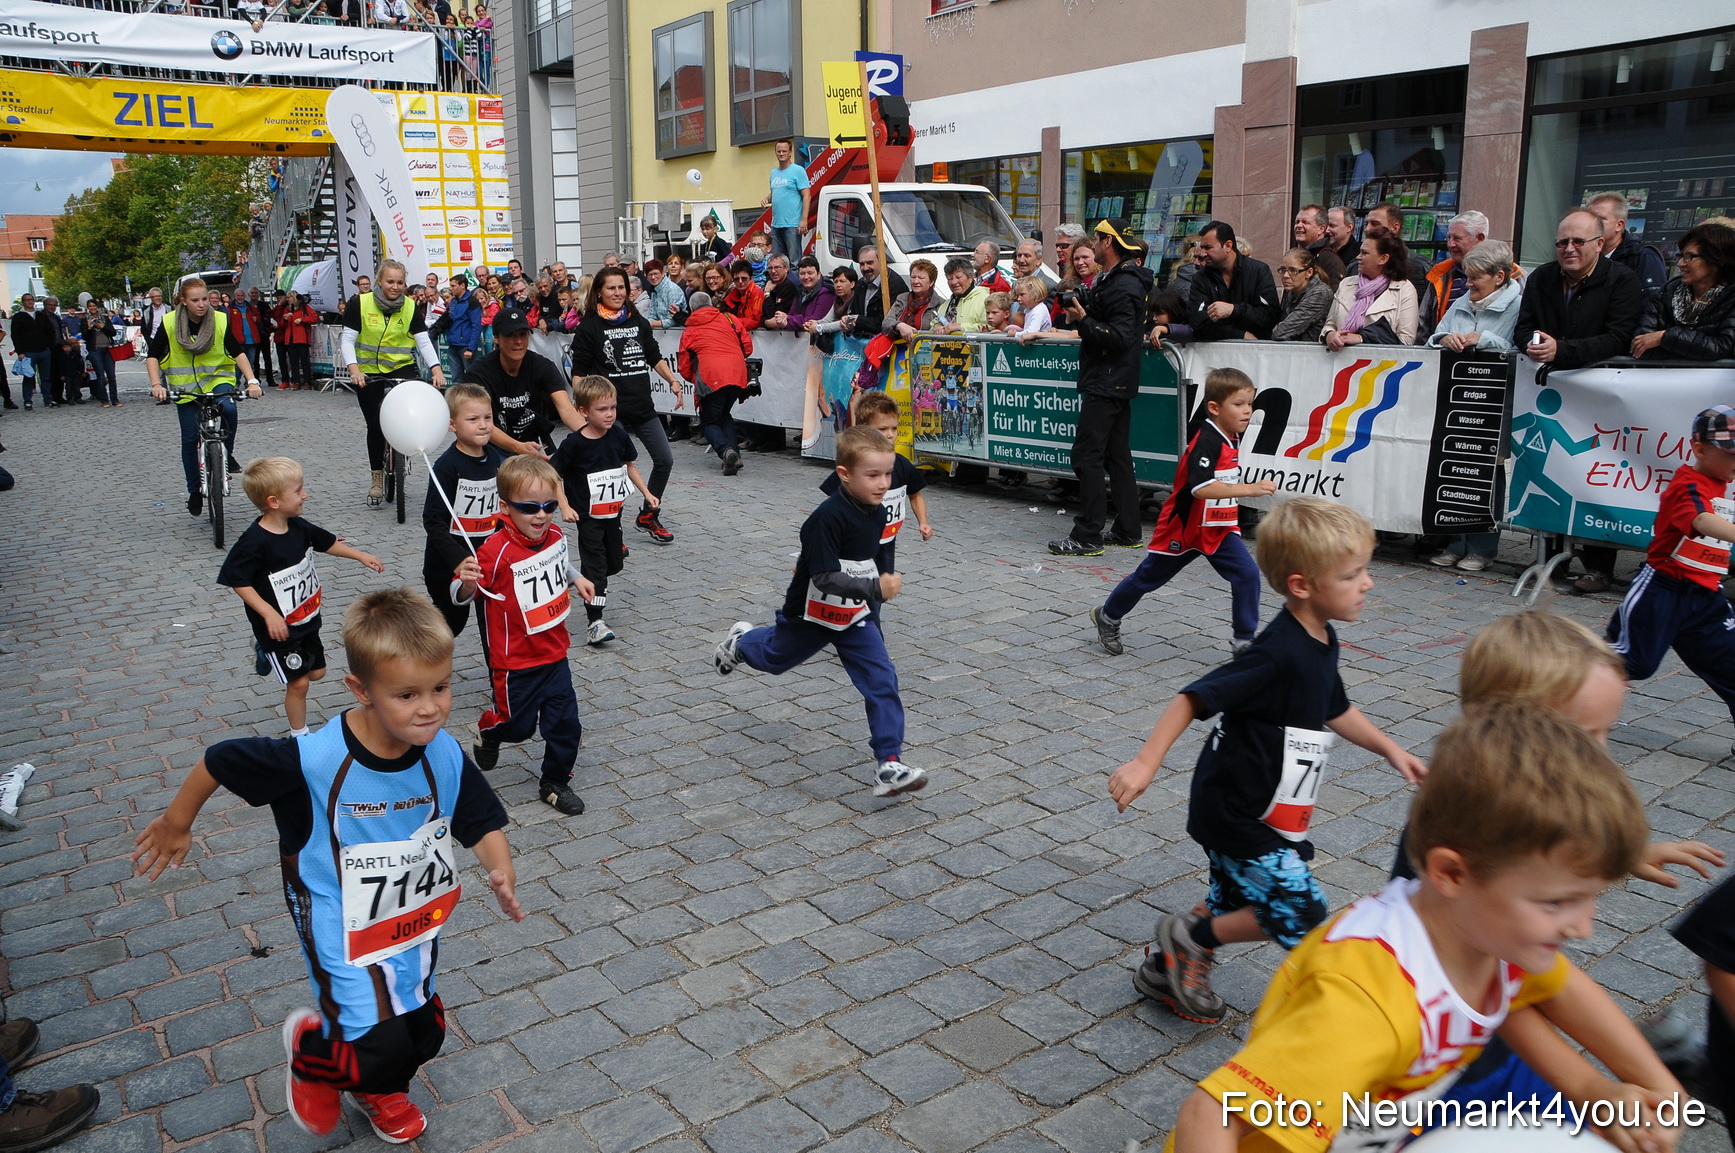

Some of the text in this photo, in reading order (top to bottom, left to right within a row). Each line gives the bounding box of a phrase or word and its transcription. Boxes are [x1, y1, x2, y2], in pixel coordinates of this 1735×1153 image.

[251, 40, 395, 65] BMW Laufsport
[826, 84, 863, 101] Jugend
[8, 103, 55, 115] Stadtlauf
[113, 91, 214, 129] ZIEL
[838, 101, 858, 115] lauf
[264, 117, 311, 126] Neumarkter
[929, 125, 947, 135] Markt
[949, 122, 956, 132] 15
[940, 356, 963, 367] erdgas
[1467, 366, 1491, 375] Strom
[992, 388, 1030, 408] Mehr
[1463, 391, 1487, 400] Erdgas
[992, 411, 1078, 437] für Ihr Even
[1458, 416, 1485, 425] Wasser
[1454, 441, 1482, 451] Wärme
[993, 445, 1013, 457] Miet
[1015, 447, 1022, 458] &
[1024, 448, 1056, 463] Service
[1451, 466, 1480, 476] Freizeit
[458, 484, 481, 493] PARTL
[1442, 490, 1481, 502] Stadtbusse
[513, 563, 538, 578] PARTL
[273, 573, 297, 588] PARTL
[345, 856, 397, 871] PARTL
[360, 848, 454, 921] 7144
[391, 912, 432, 941] Joris
